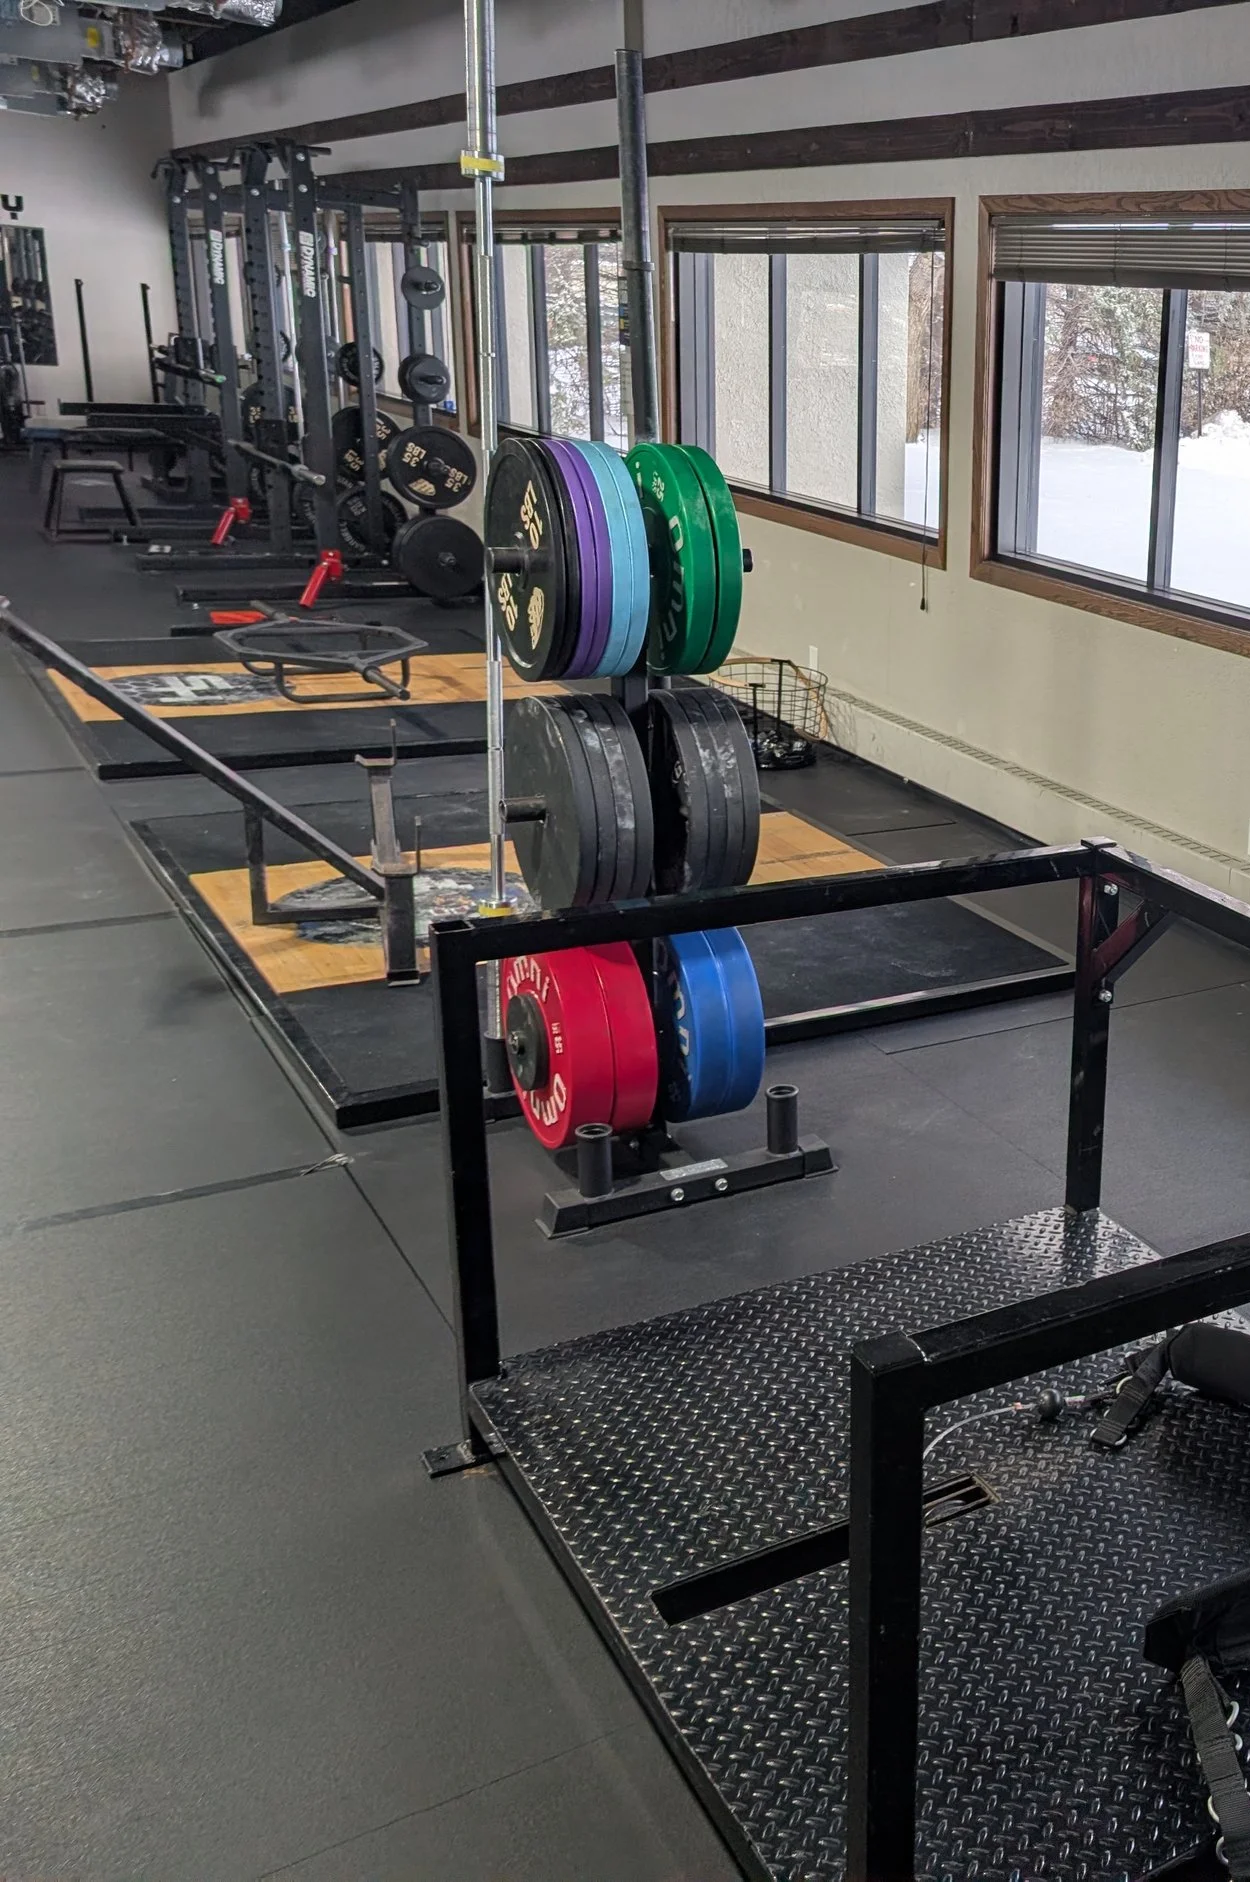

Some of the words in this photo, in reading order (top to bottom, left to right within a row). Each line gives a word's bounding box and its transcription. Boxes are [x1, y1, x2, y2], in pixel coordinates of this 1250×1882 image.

[300, 245, 317, 298] DYNAMIC
[401, 452, 420, 467] 35
[405, 442, 427, 460] LBS
[444, 477, 462, 493] 35
[448, 467, 468, 485] LBS
[520, 480, 537, 530] LBS
[529, 511, 543, 550] 10
[497, 573, 513, 612] LBS
[505, 596, 519, 632] 10
